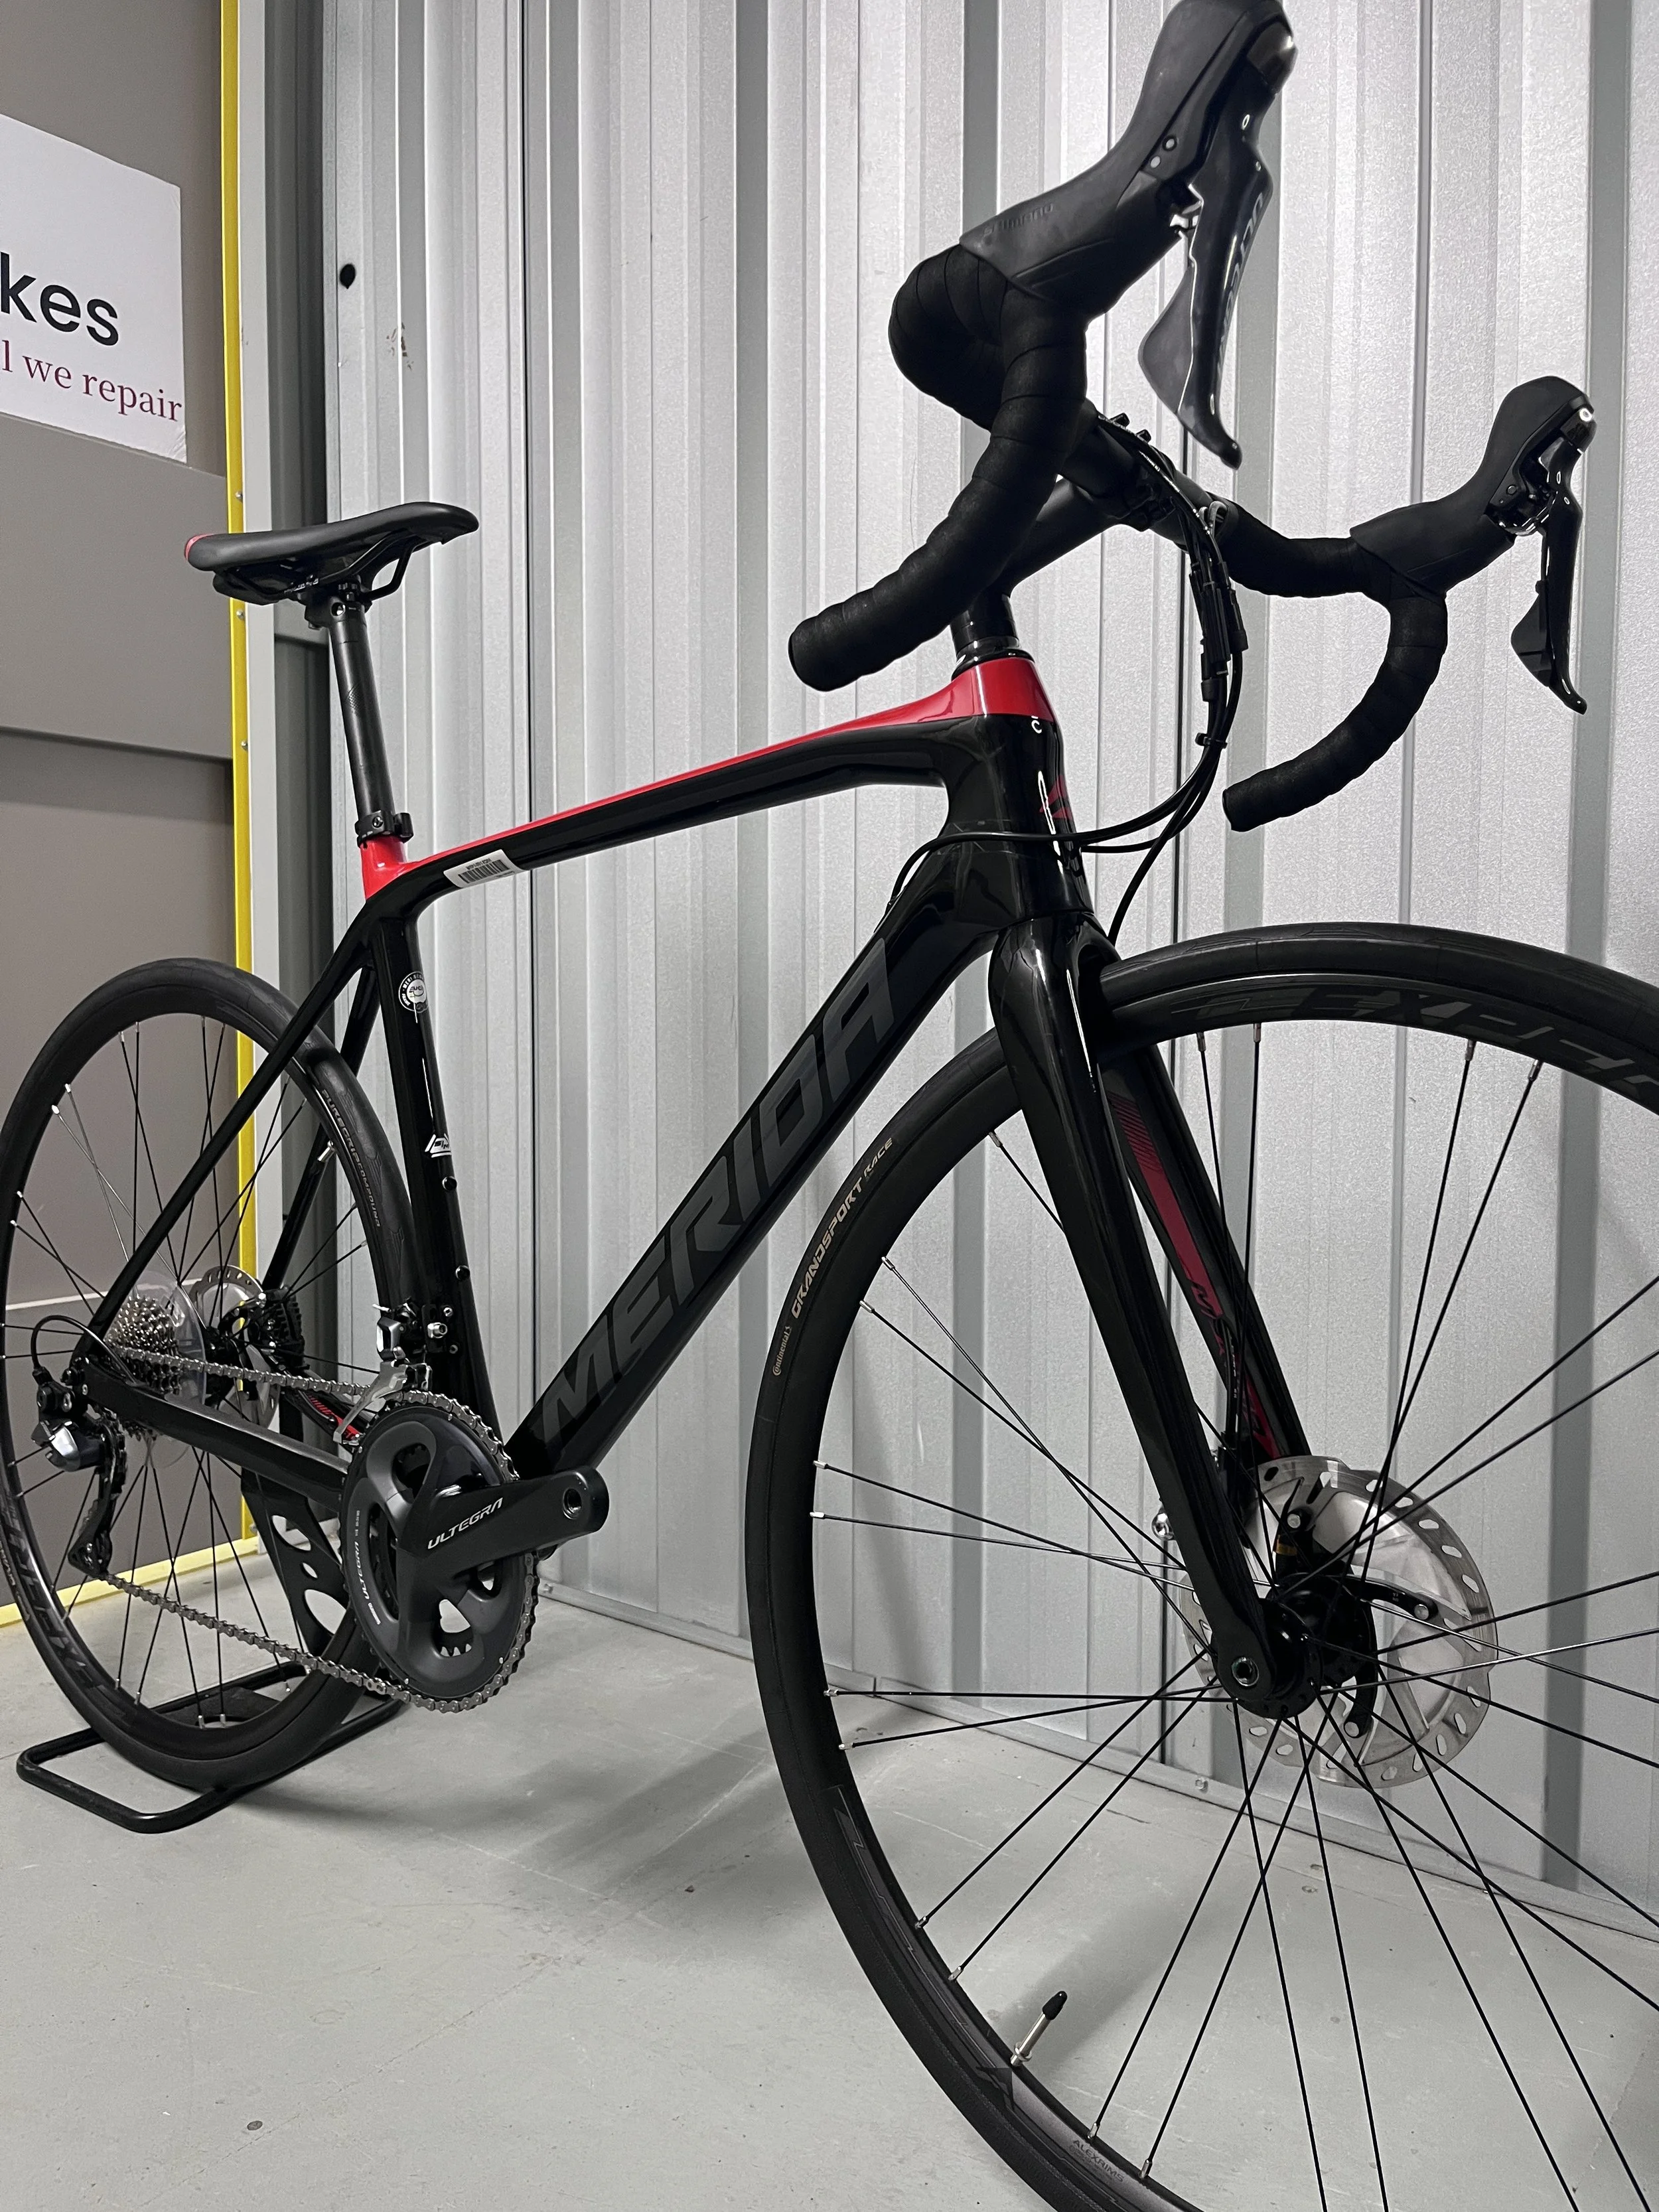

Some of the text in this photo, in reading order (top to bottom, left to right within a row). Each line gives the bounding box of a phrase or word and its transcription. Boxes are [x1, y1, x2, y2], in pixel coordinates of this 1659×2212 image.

[22, 356, 71, 389] we
[82, 375, 182, 422] repair
[532, 938, 895, 1441] MERIDA
[791, 1138, 894, 1319] GRANDSPORT RACE
[427, 1497, 504, 1550] ULTEGRA
[354, 1540, 370, 1600] ULTEGRA
[1072, 2140, 1125, 2182] ALEXRIMS
